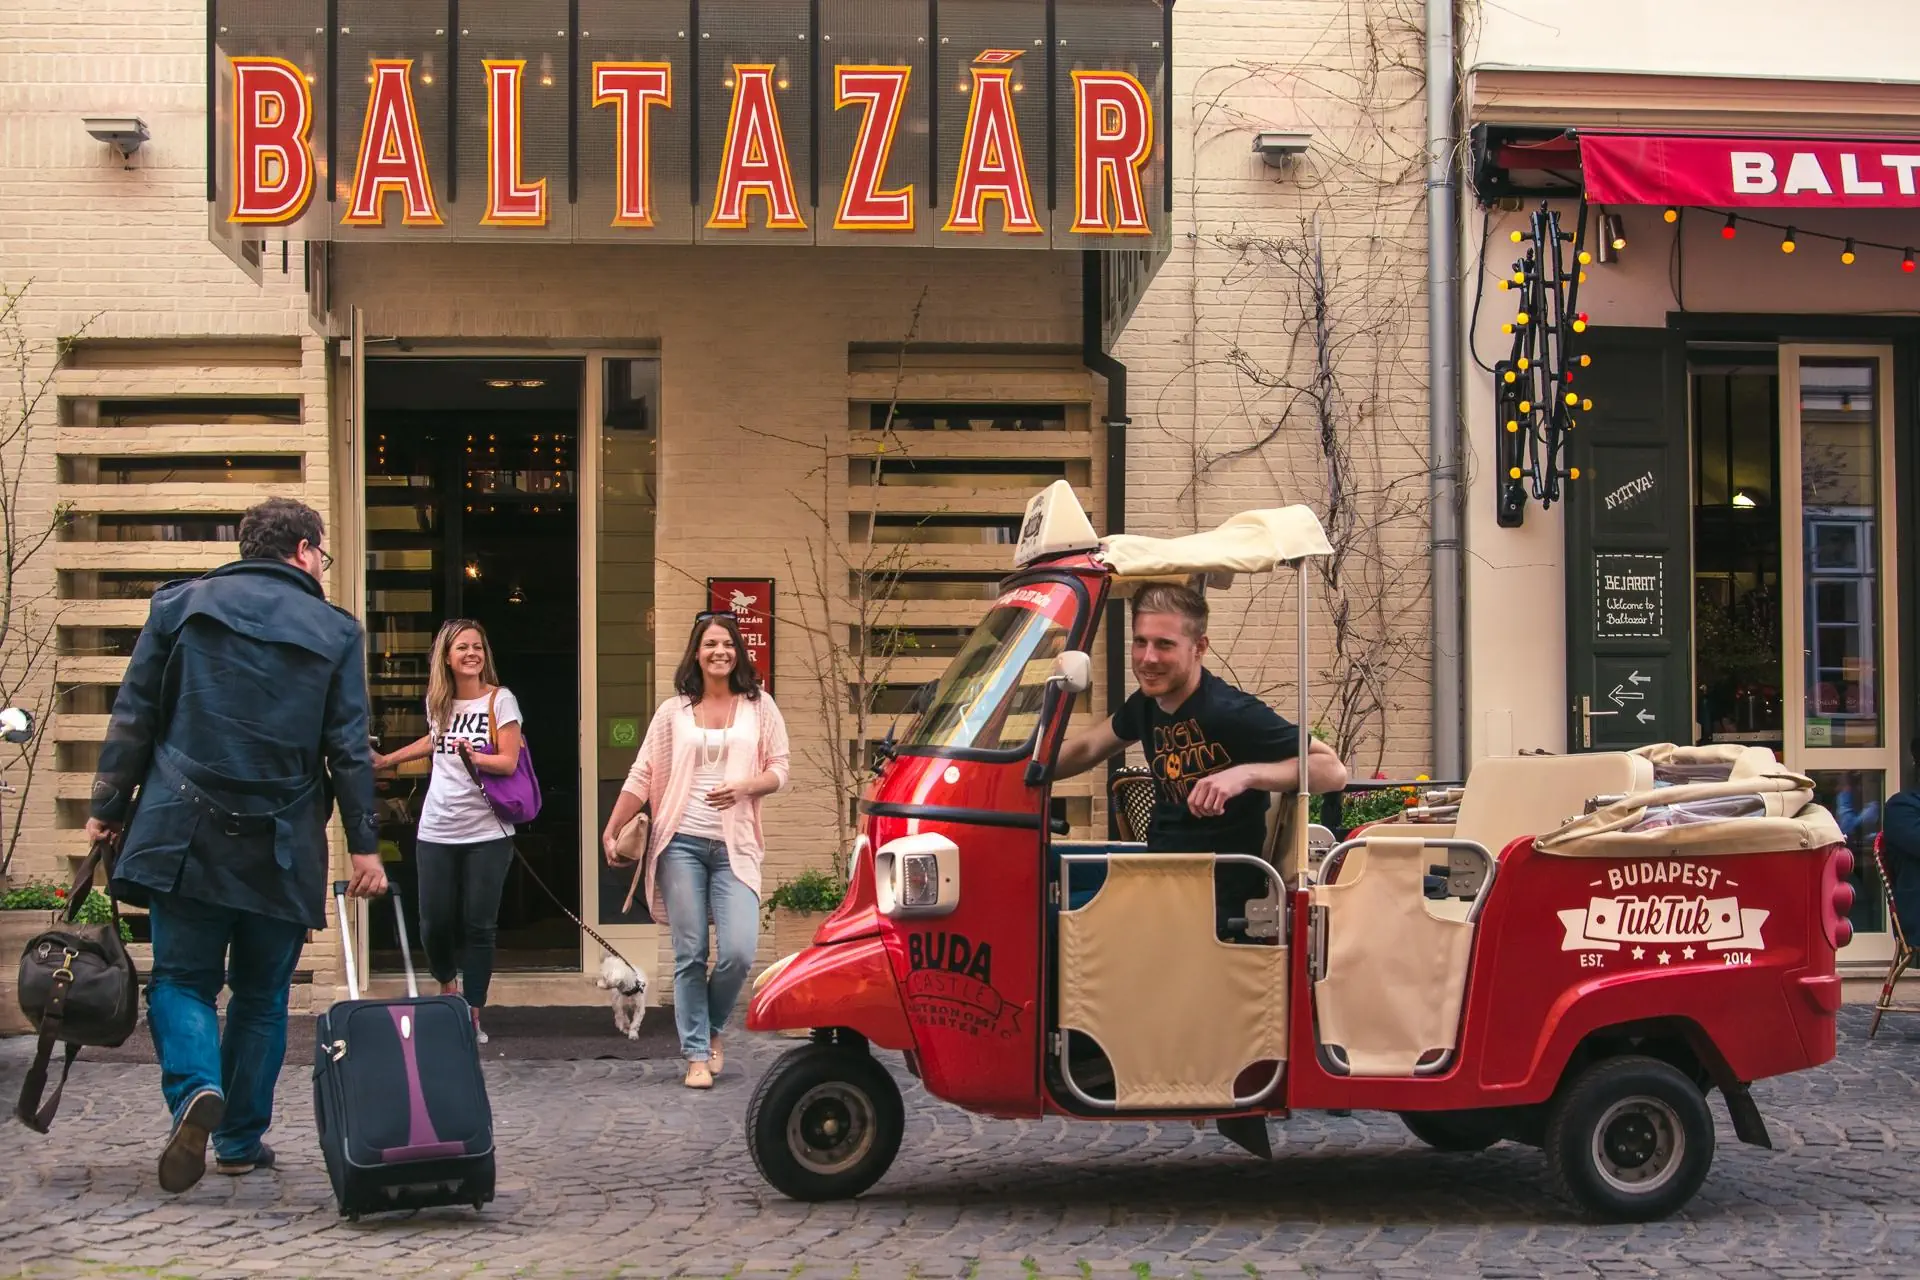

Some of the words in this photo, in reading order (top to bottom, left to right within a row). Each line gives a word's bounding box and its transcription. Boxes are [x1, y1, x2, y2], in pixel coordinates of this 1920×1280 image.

[226, 48, 1153, 234] BALTAZÁR
[1604, 471, 1655, 510] NYITVA!
[1604, 569, 1656, 591] BEJÁRAT
[1606, 597, 1643, 610] Welcome
[1645, 596, 1655, 610] to
[444, 713, 489, 734] IKE
[1607, 861, 1722, 891] BUDAPEST
[908, 931, 992, 986] BUDA
[1580, 953, 1605, 968] EST.
[1722, 951, 1752, 966] 2014
[913, 973, 986, 1004] CASTLE
